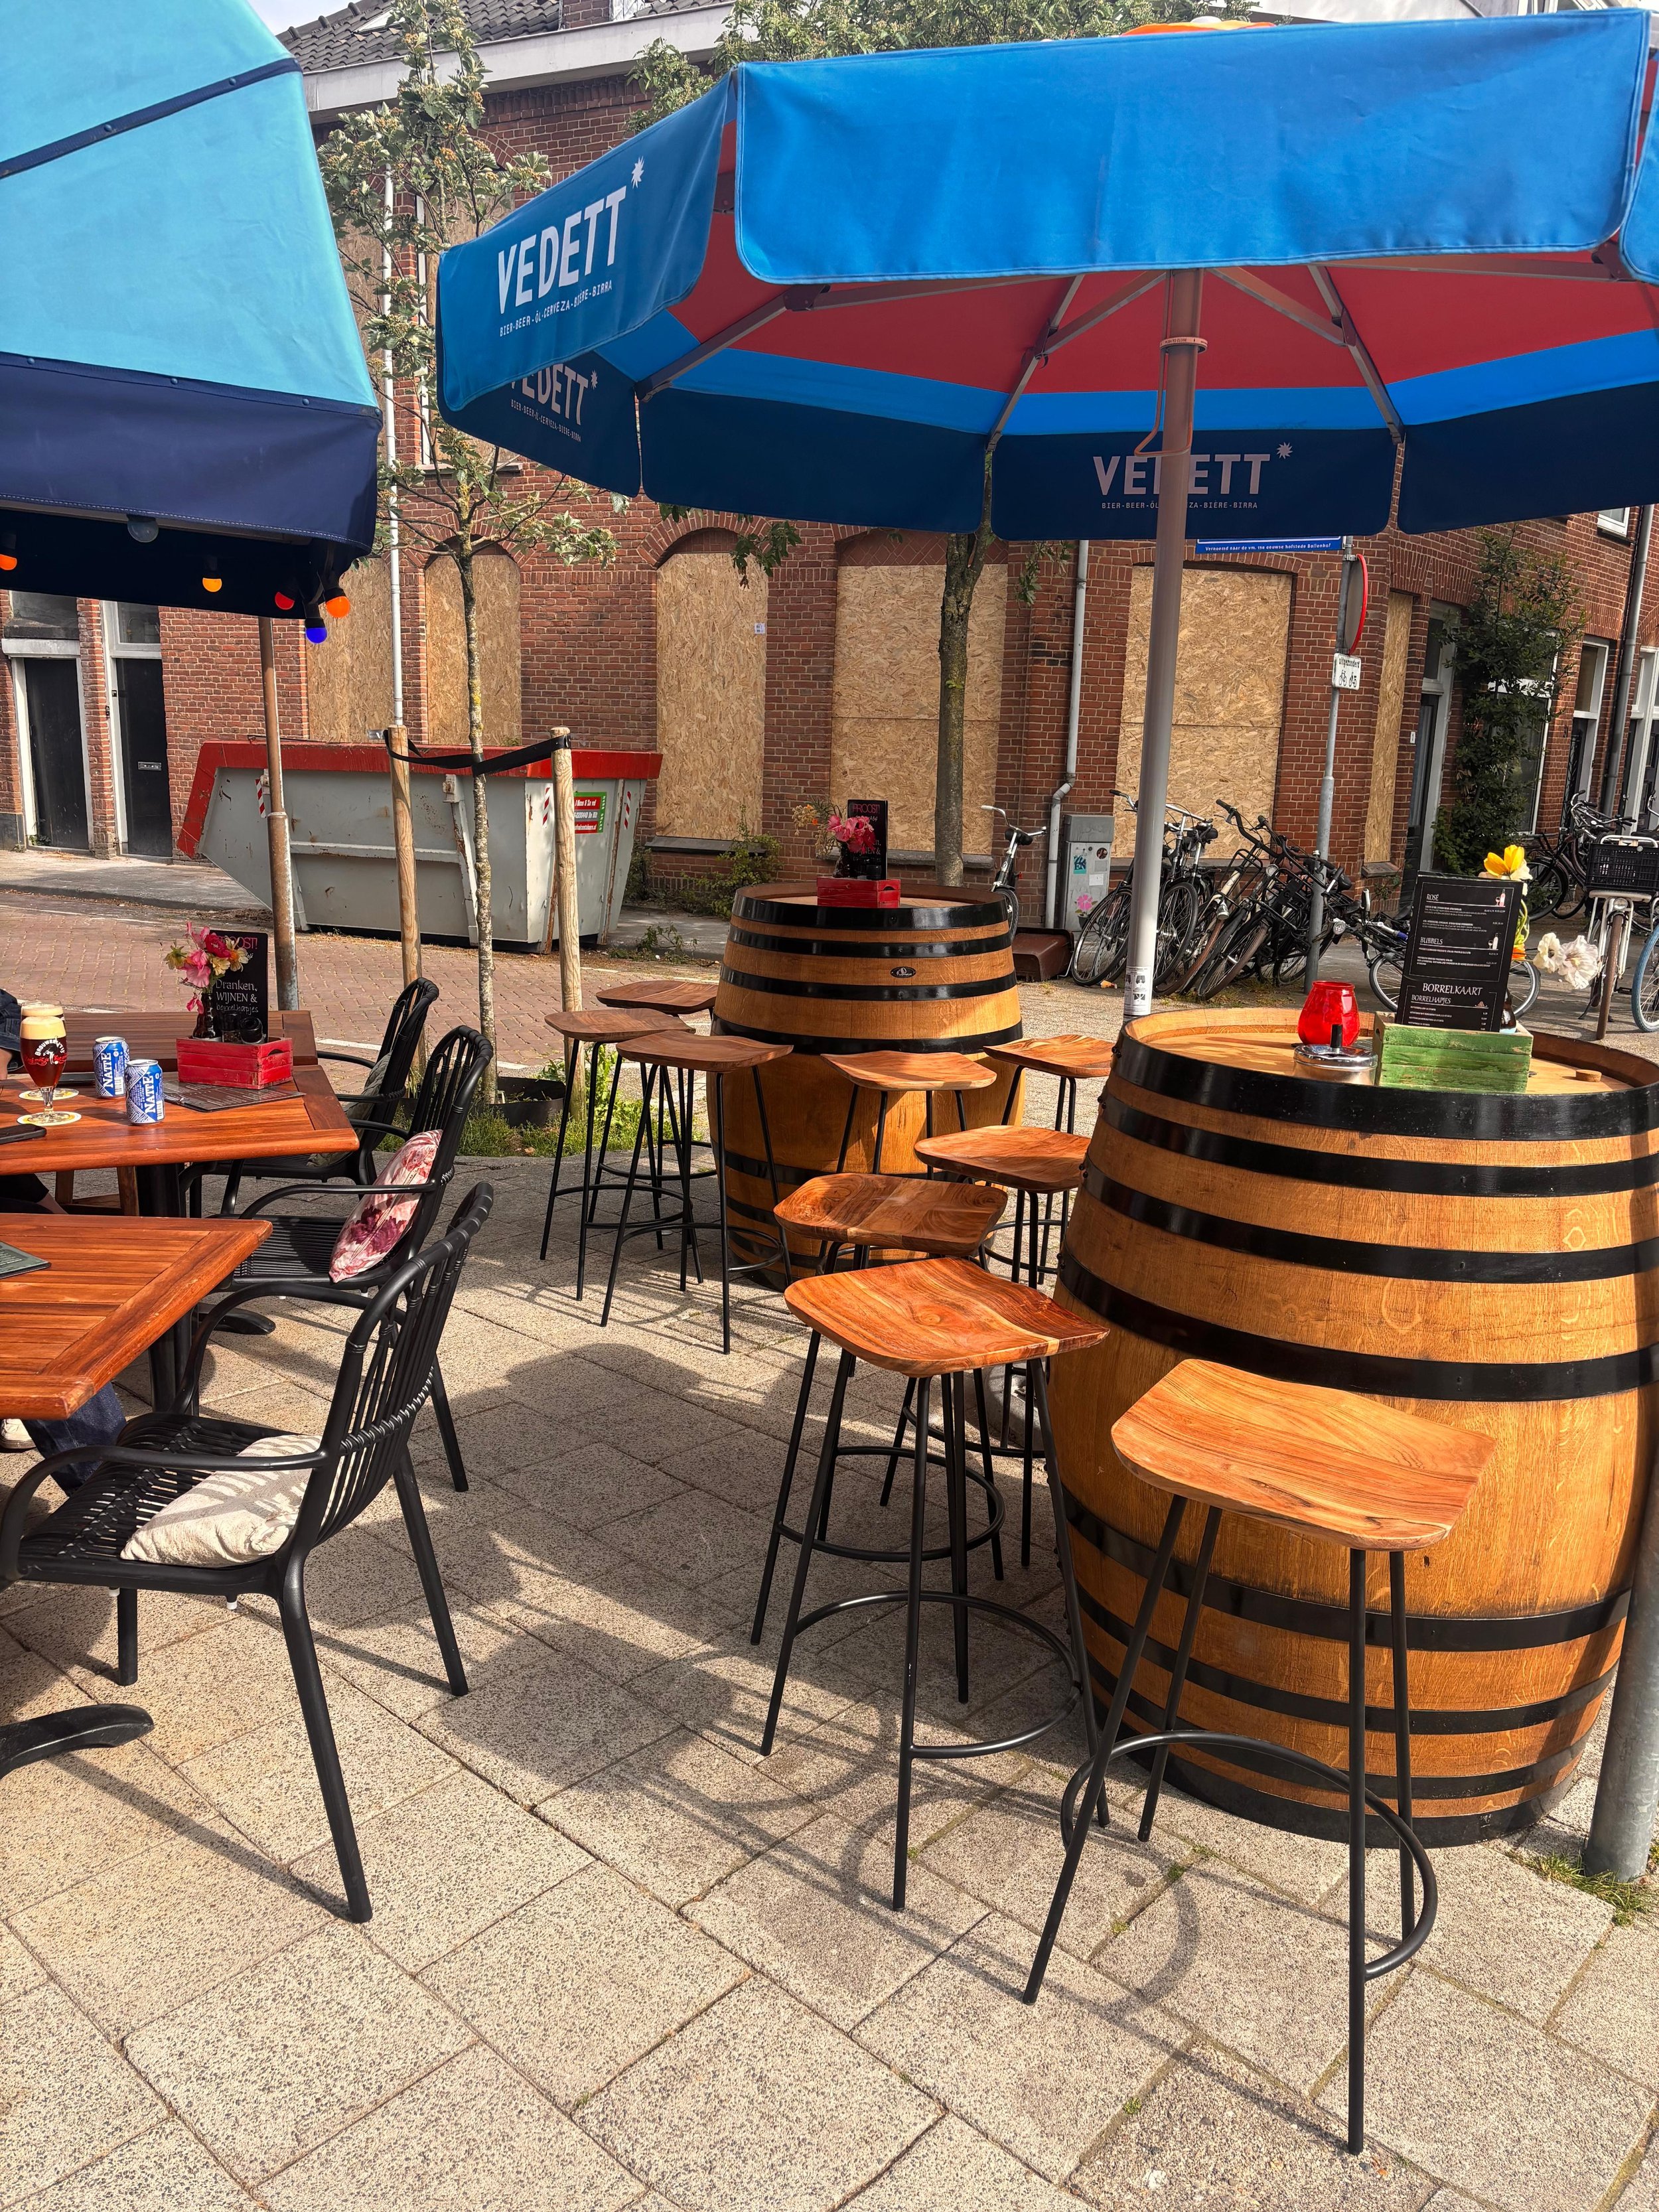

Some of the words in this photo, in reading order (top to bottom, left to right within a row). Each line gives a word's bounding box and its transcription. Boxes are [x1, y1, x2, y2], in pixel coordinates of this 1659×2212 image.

[498, 186, 626, 315] VEDETT
[511, 364, 589, 425] DETT
[1093, 454, 1270, 496] VEETT
[1338, 658, 1360, 668] uitgezonderd
[852, 804, 881, 814] PROOST!
[218, 935, 257, 950] OST!
[1420, 936, 1443, 945] BUBBELS
[216, 980, 257, 992] Dranken,
[1422, 983, 1483, 995] BORRELKAART
[216, 992, 248, 1004] WIJNEN
[250, 994, 257, 1003] &
[1411, 994, 1451, 1005] BORRELHAPJES
[216, 1003, 259, 1015] borrelhapjes
[101, 1053, 113, 1088] NATTE
[143, 1075, 156, 1114] NATTE
